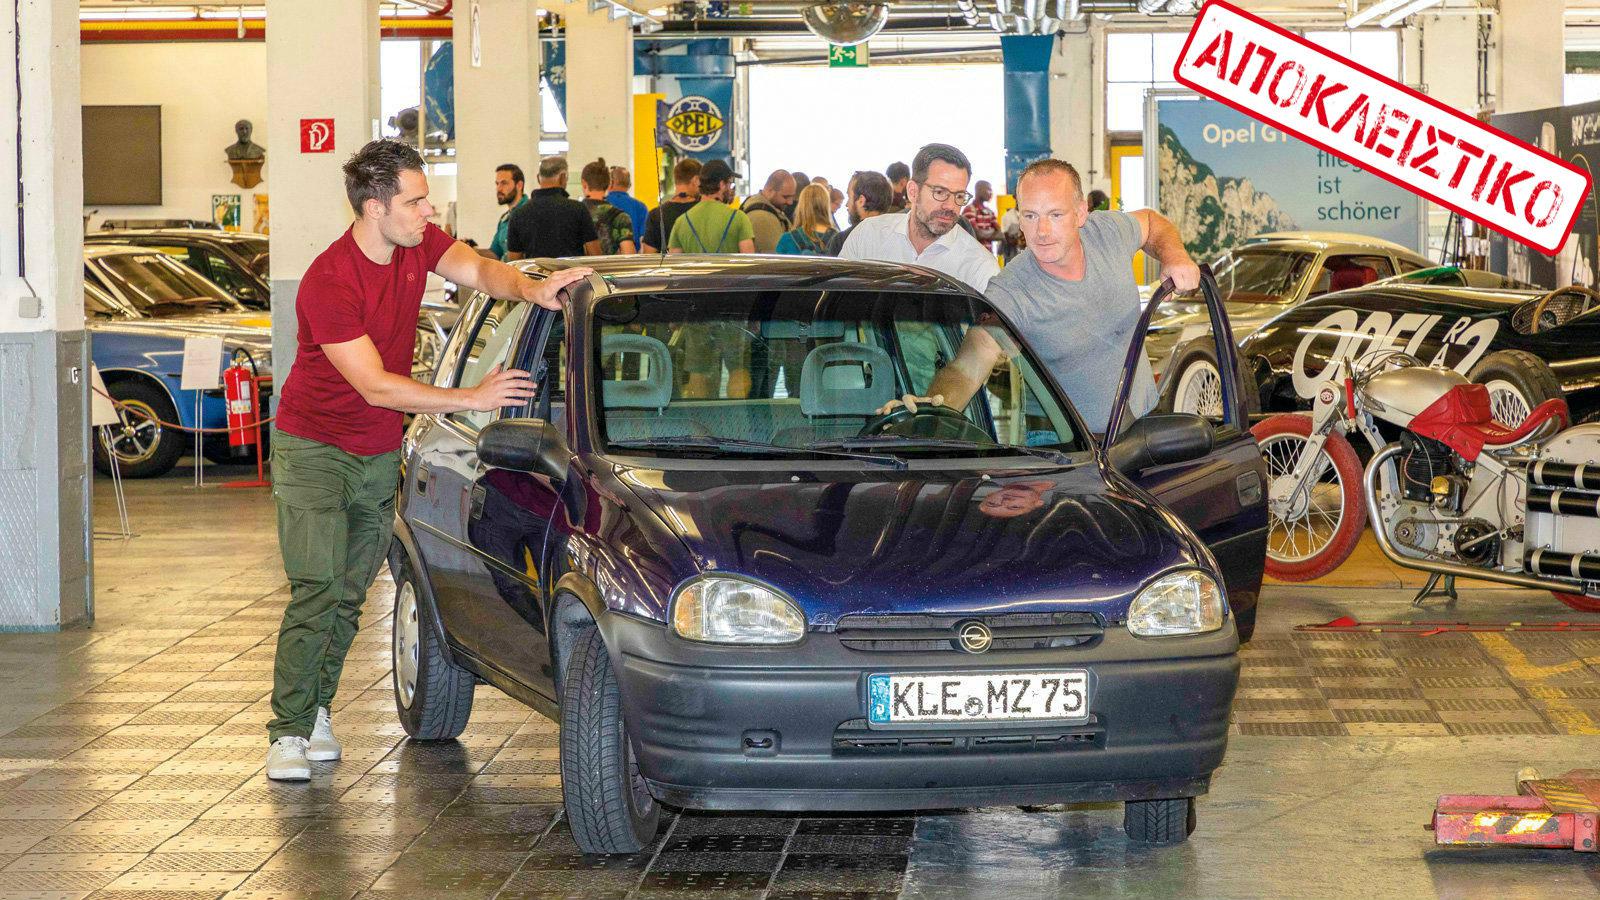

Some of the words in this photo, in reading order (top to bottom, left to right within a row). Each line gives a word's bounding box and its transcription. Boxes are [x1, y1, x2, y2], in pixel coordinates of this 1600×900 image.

[673, 114, 717, 134] OPEL
[1203, 122, 1255, 148] Opel
[1317, 175, 1342, 194] ist
[1317, 201, 1401, 220] schöner
[893, 680, 963, 717] KLE
[987, 679, 1032, 713] MZ
[1041, 678, 1083, 712] 75
